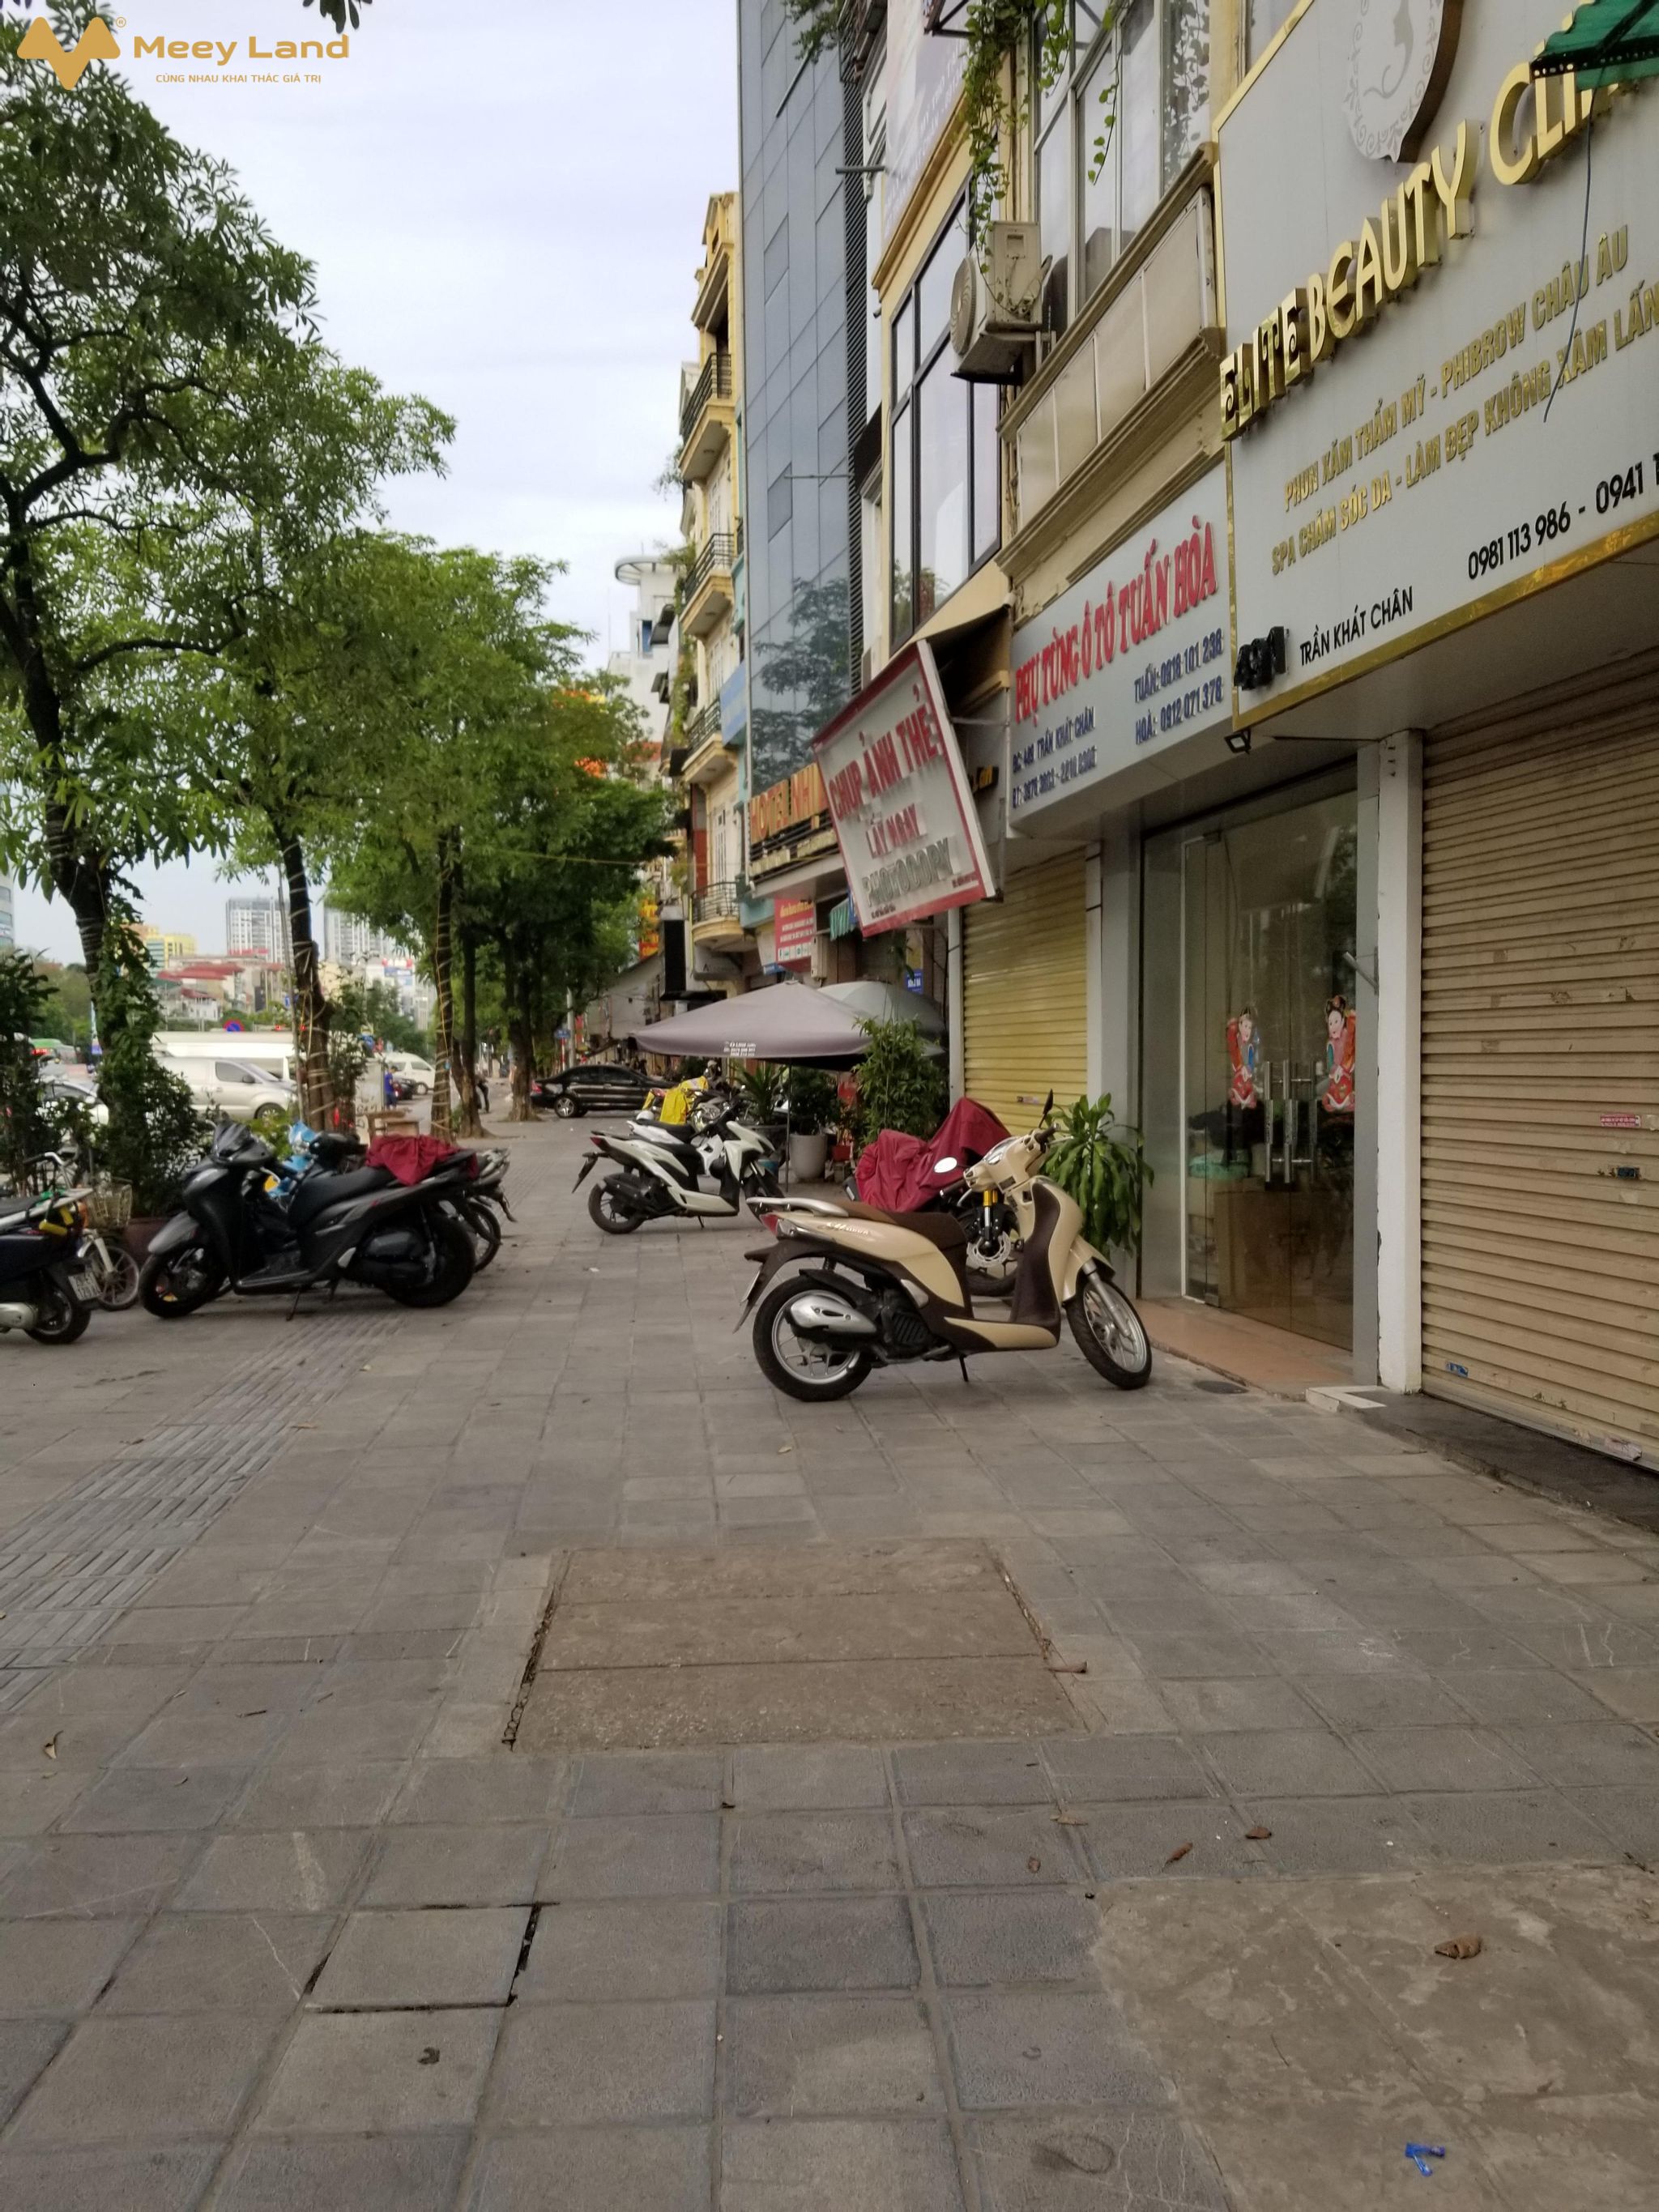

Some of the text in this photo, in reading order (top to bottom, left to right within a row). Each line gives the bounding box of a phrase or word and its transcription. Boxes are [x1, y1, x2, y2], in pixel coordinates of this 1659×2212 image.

[1219, 288, 1306, 441] ELITE
[1307, 119, 1471, 362] BEAUTY
[1284, 459, 1319, 513] PHUN
[1322, 437, 1353, 485] XĂM
[1354, 398, 1397, 461] THẨM
[1401, 377, 1426, 428] MỸ
[1441, 302, 1526, 398] PHIBROW
[1597, 224, 1627, 287] ÂU
[1272, 535, 1297, 575] SPA
[1299, 505, 1337, 558] CHĂM
[1339, 484, 1368, 531] SÓC
[1371, 470, 1392, 512] DA
[1405, 435, 1441, 488] LÀM
[1445, 411, 1480, 462] ĐẸP
[1484, 364, 1551, 436] KHÔNG
[1468, 536, 1504, 580] 0981
[1508, 522, 1531, 560] 113
[1534, 501, 1571, 546] 986
[1595, 461, 1644, 514] 0941
[1015, 650, 1041, 727] PHỤ
[1042, 624, 1080, 707] TÙNG
[1081, 600, 1094, 680] Ô
[1094, 581, 1116, 671] TÔ
[1118, 538, 1171, 654] TUẤN
[1299, 624, 1330, 666] TRẦN
[1333, 604, 1367, 650] KHÁT
[1370, 585, 1414, 630] CHÂN
[1160, 697, 1183, 732] 0912
[1202, 675, 1222, 710] 378
[749, 779, 791, 845] HOTEL
[887, 803, 921, 848] NGAY
[862, 837, 954, 908] PHOTOCOPY
